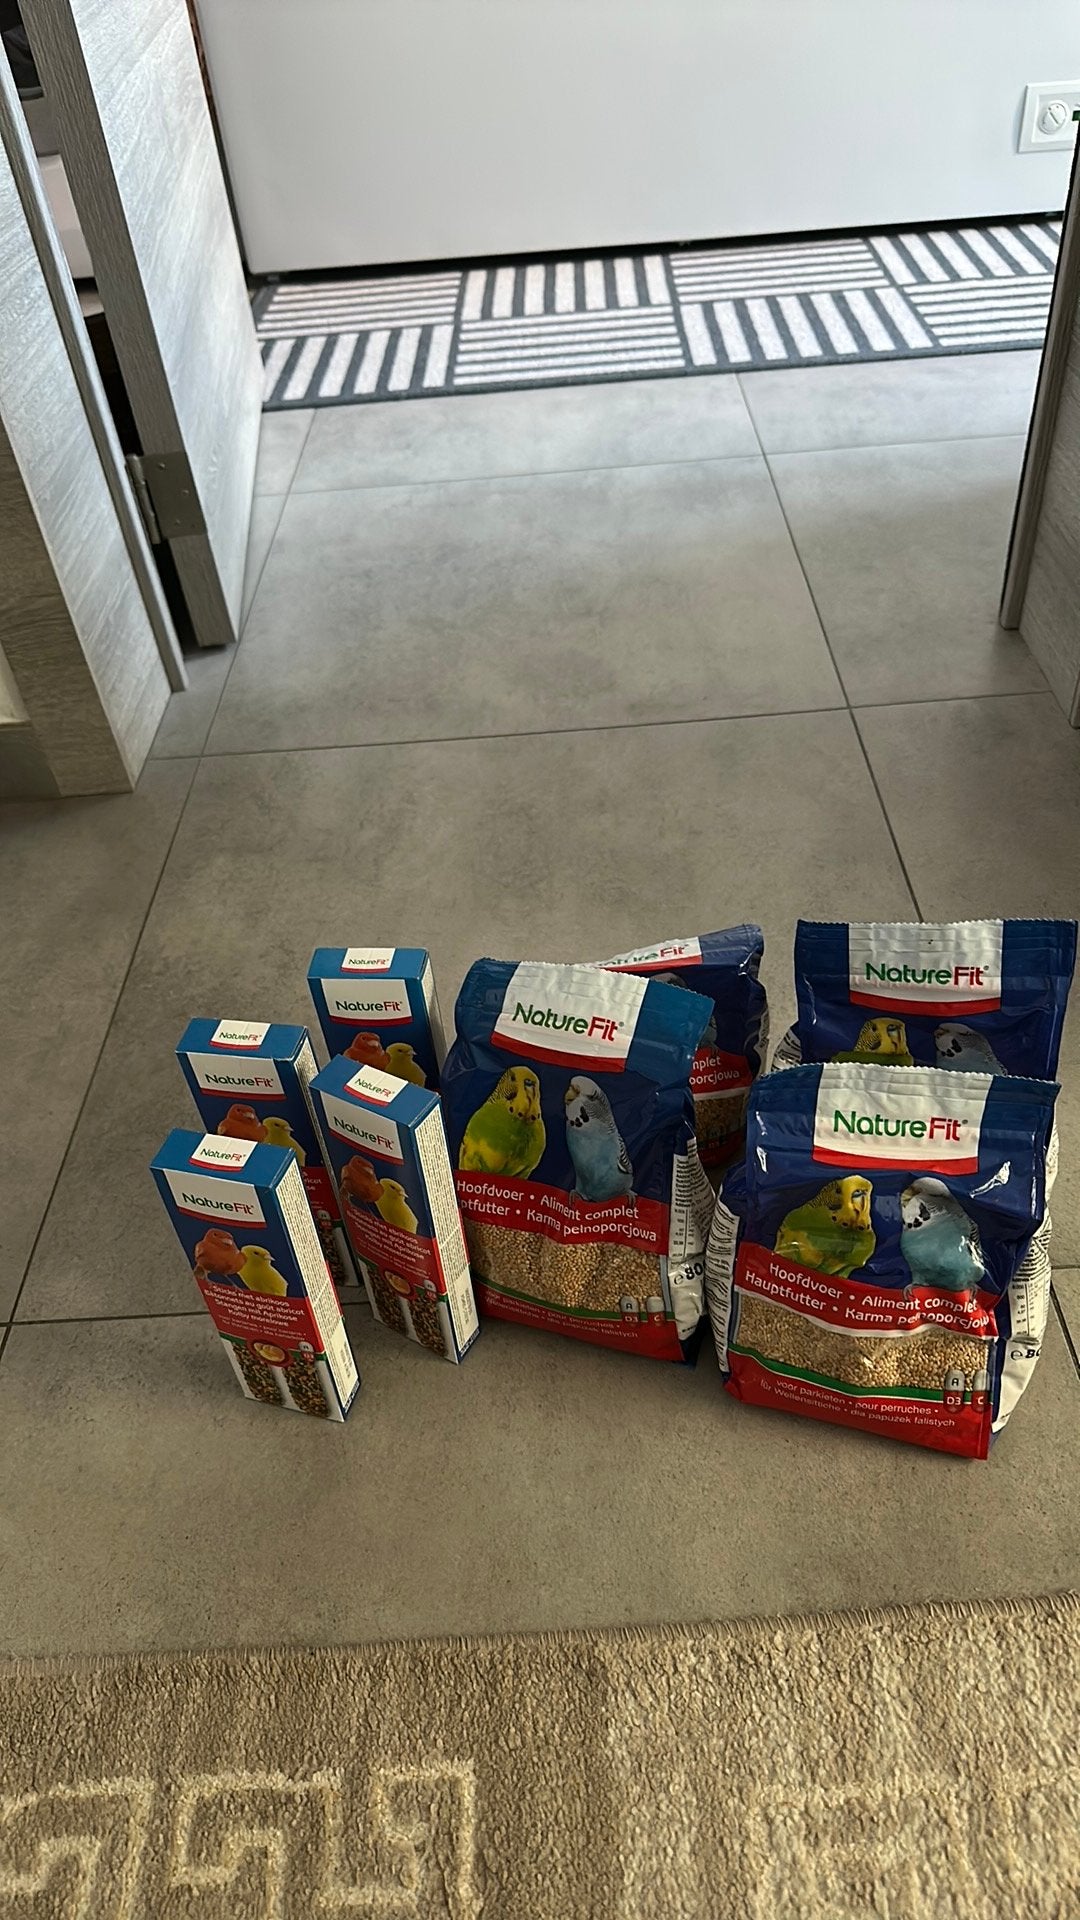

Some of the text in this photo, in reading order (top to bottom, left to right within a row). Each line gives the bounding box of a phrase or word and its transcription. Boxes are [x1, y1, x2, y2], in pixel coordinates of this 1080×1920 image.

[456, 1180, 639, 1221] Hoofdvoer Aliment complet
[460, 1198, 511, 1217] ptfutter
[526, 1207, 561, 1232] Karma
[745, 1270, 827, 1311] Hauptfutter
[845, 1307, 893, 1323] Karma
[769, 1262, 978, 1313] Hoofdvoer Aliment complet
[776, 1380, 932, 1415] voor parkieten pour perruches
[946, 1396, 961, 1406] D3
[976, 1396, 984, 1405] C
